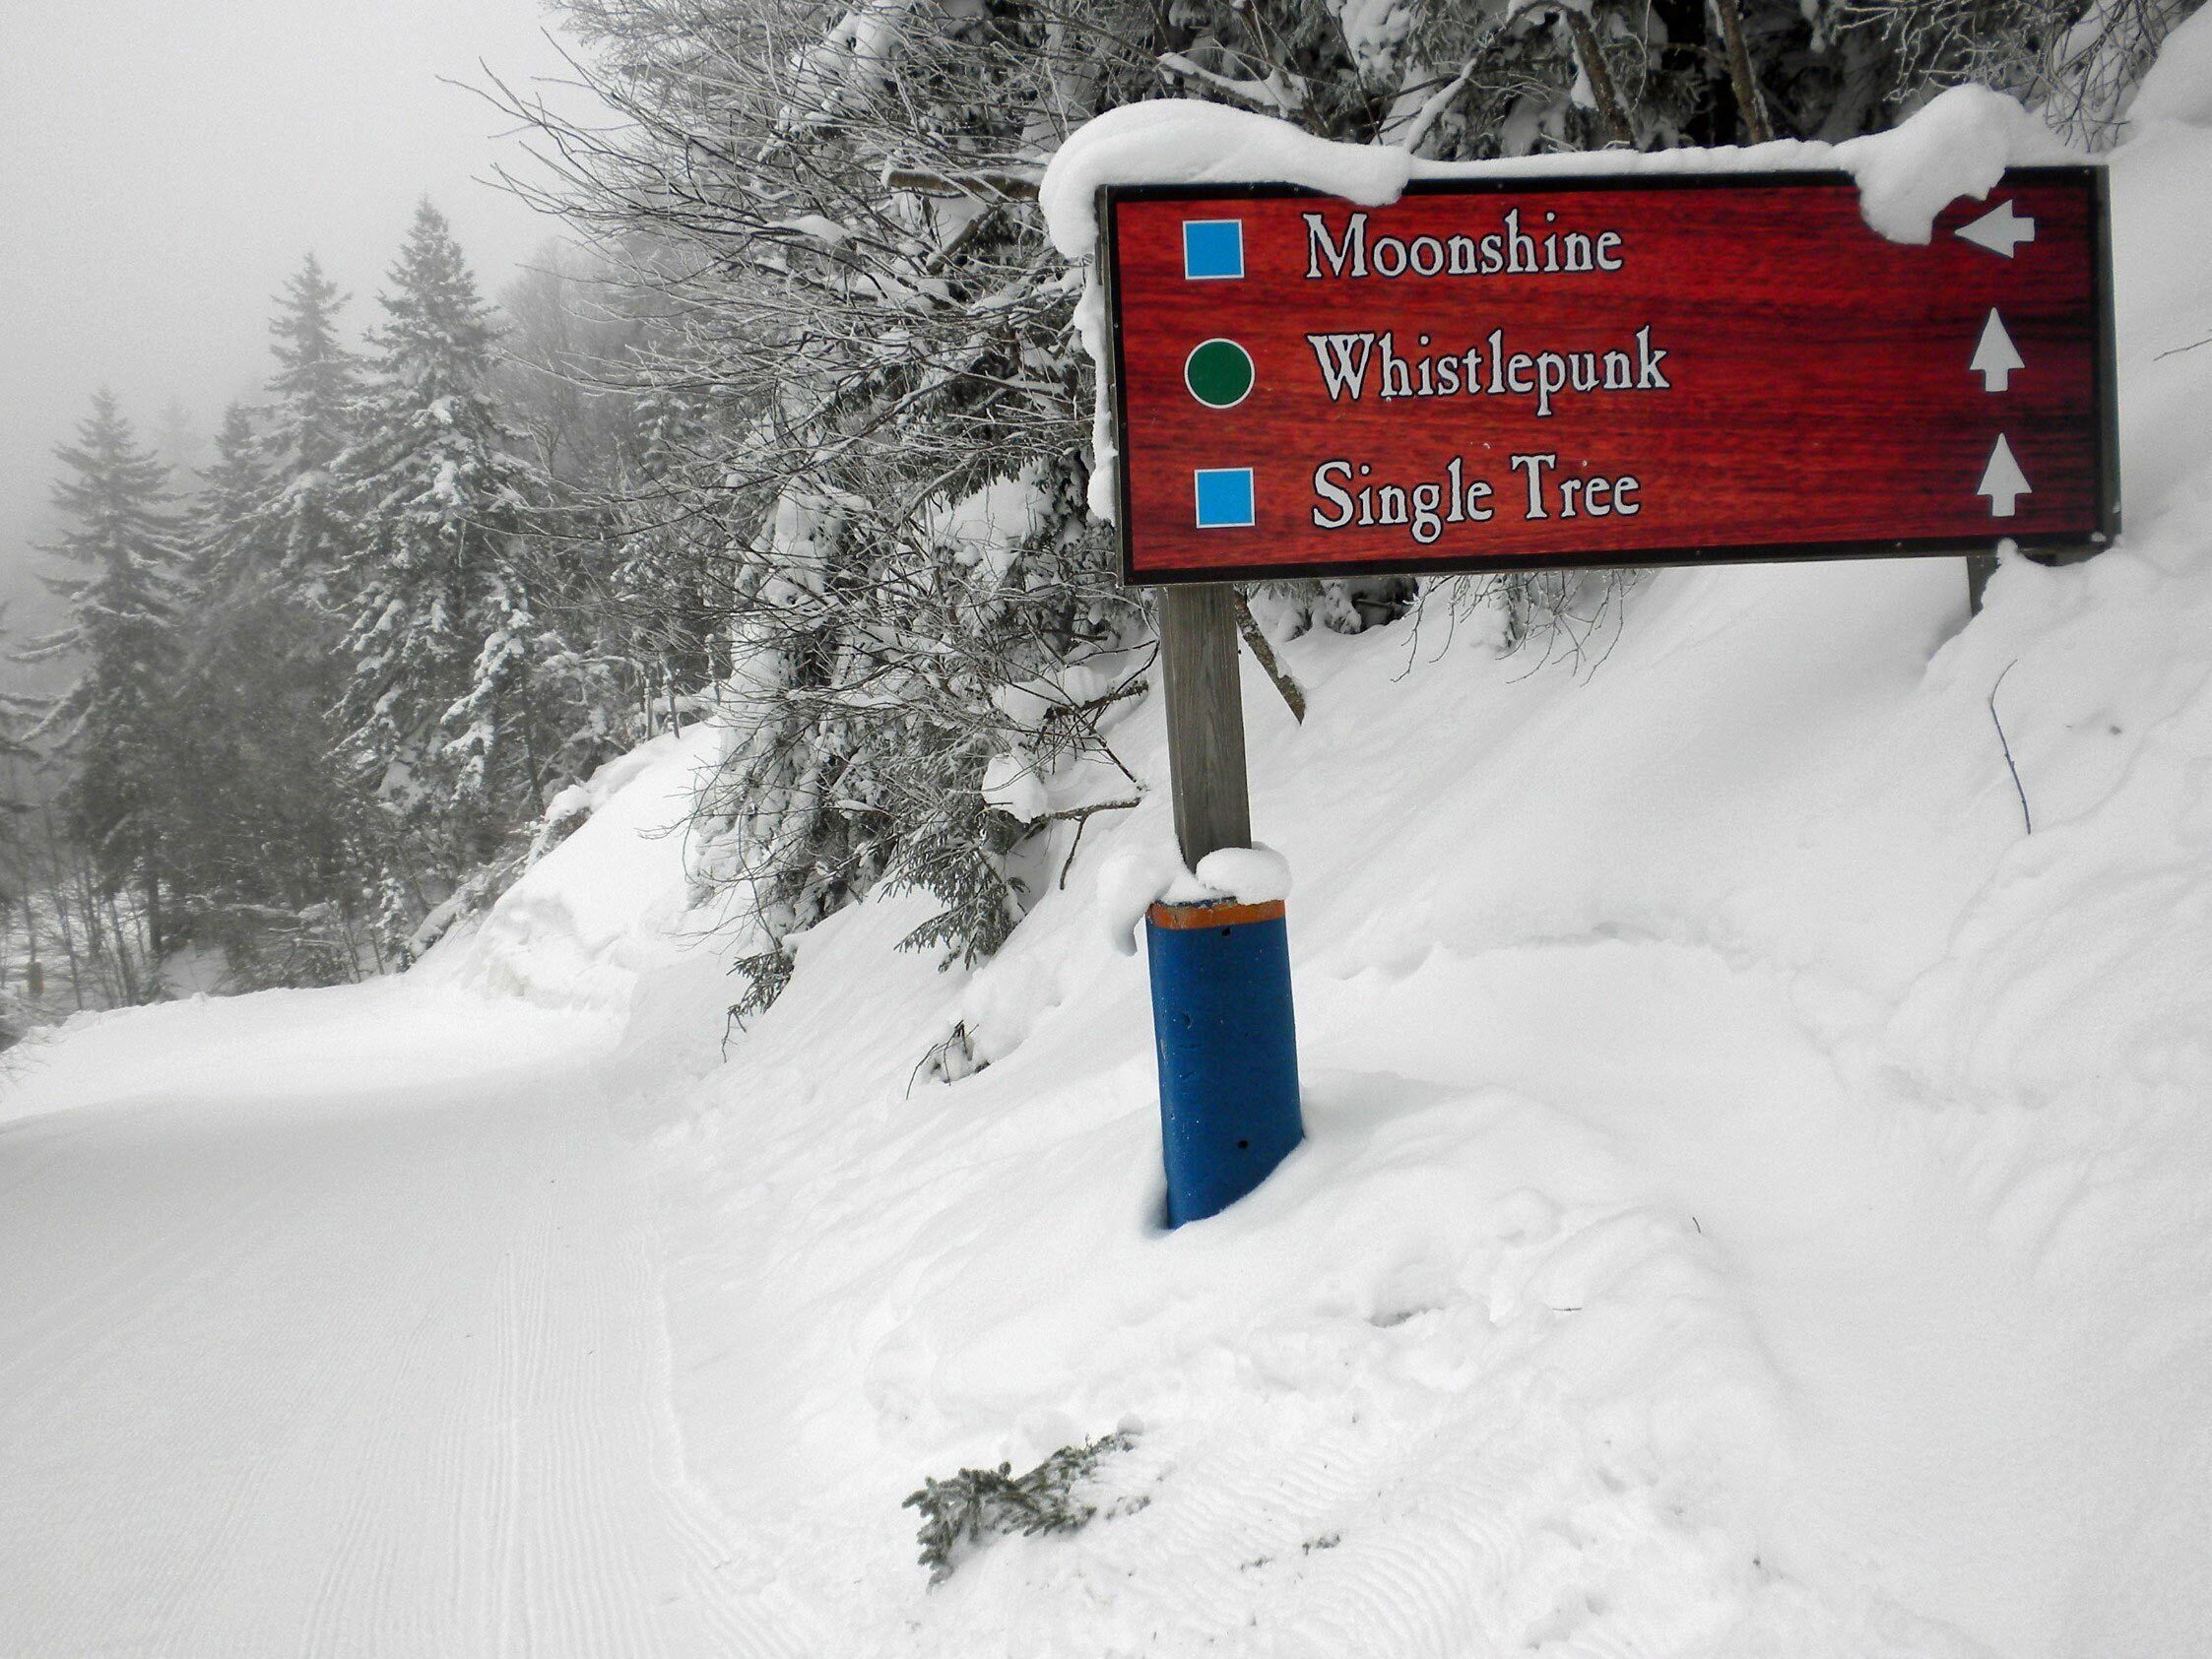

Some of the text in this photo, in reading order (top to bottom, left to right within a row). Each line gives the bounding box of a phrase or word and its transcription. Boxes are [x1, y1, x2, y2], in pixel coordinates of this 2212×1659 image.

[1303, 208, 1623, 279] Moonshine
[1306, 325, 1670, 415] Whistlepunk
[1312, 453, 1641, 543] Single Tree
